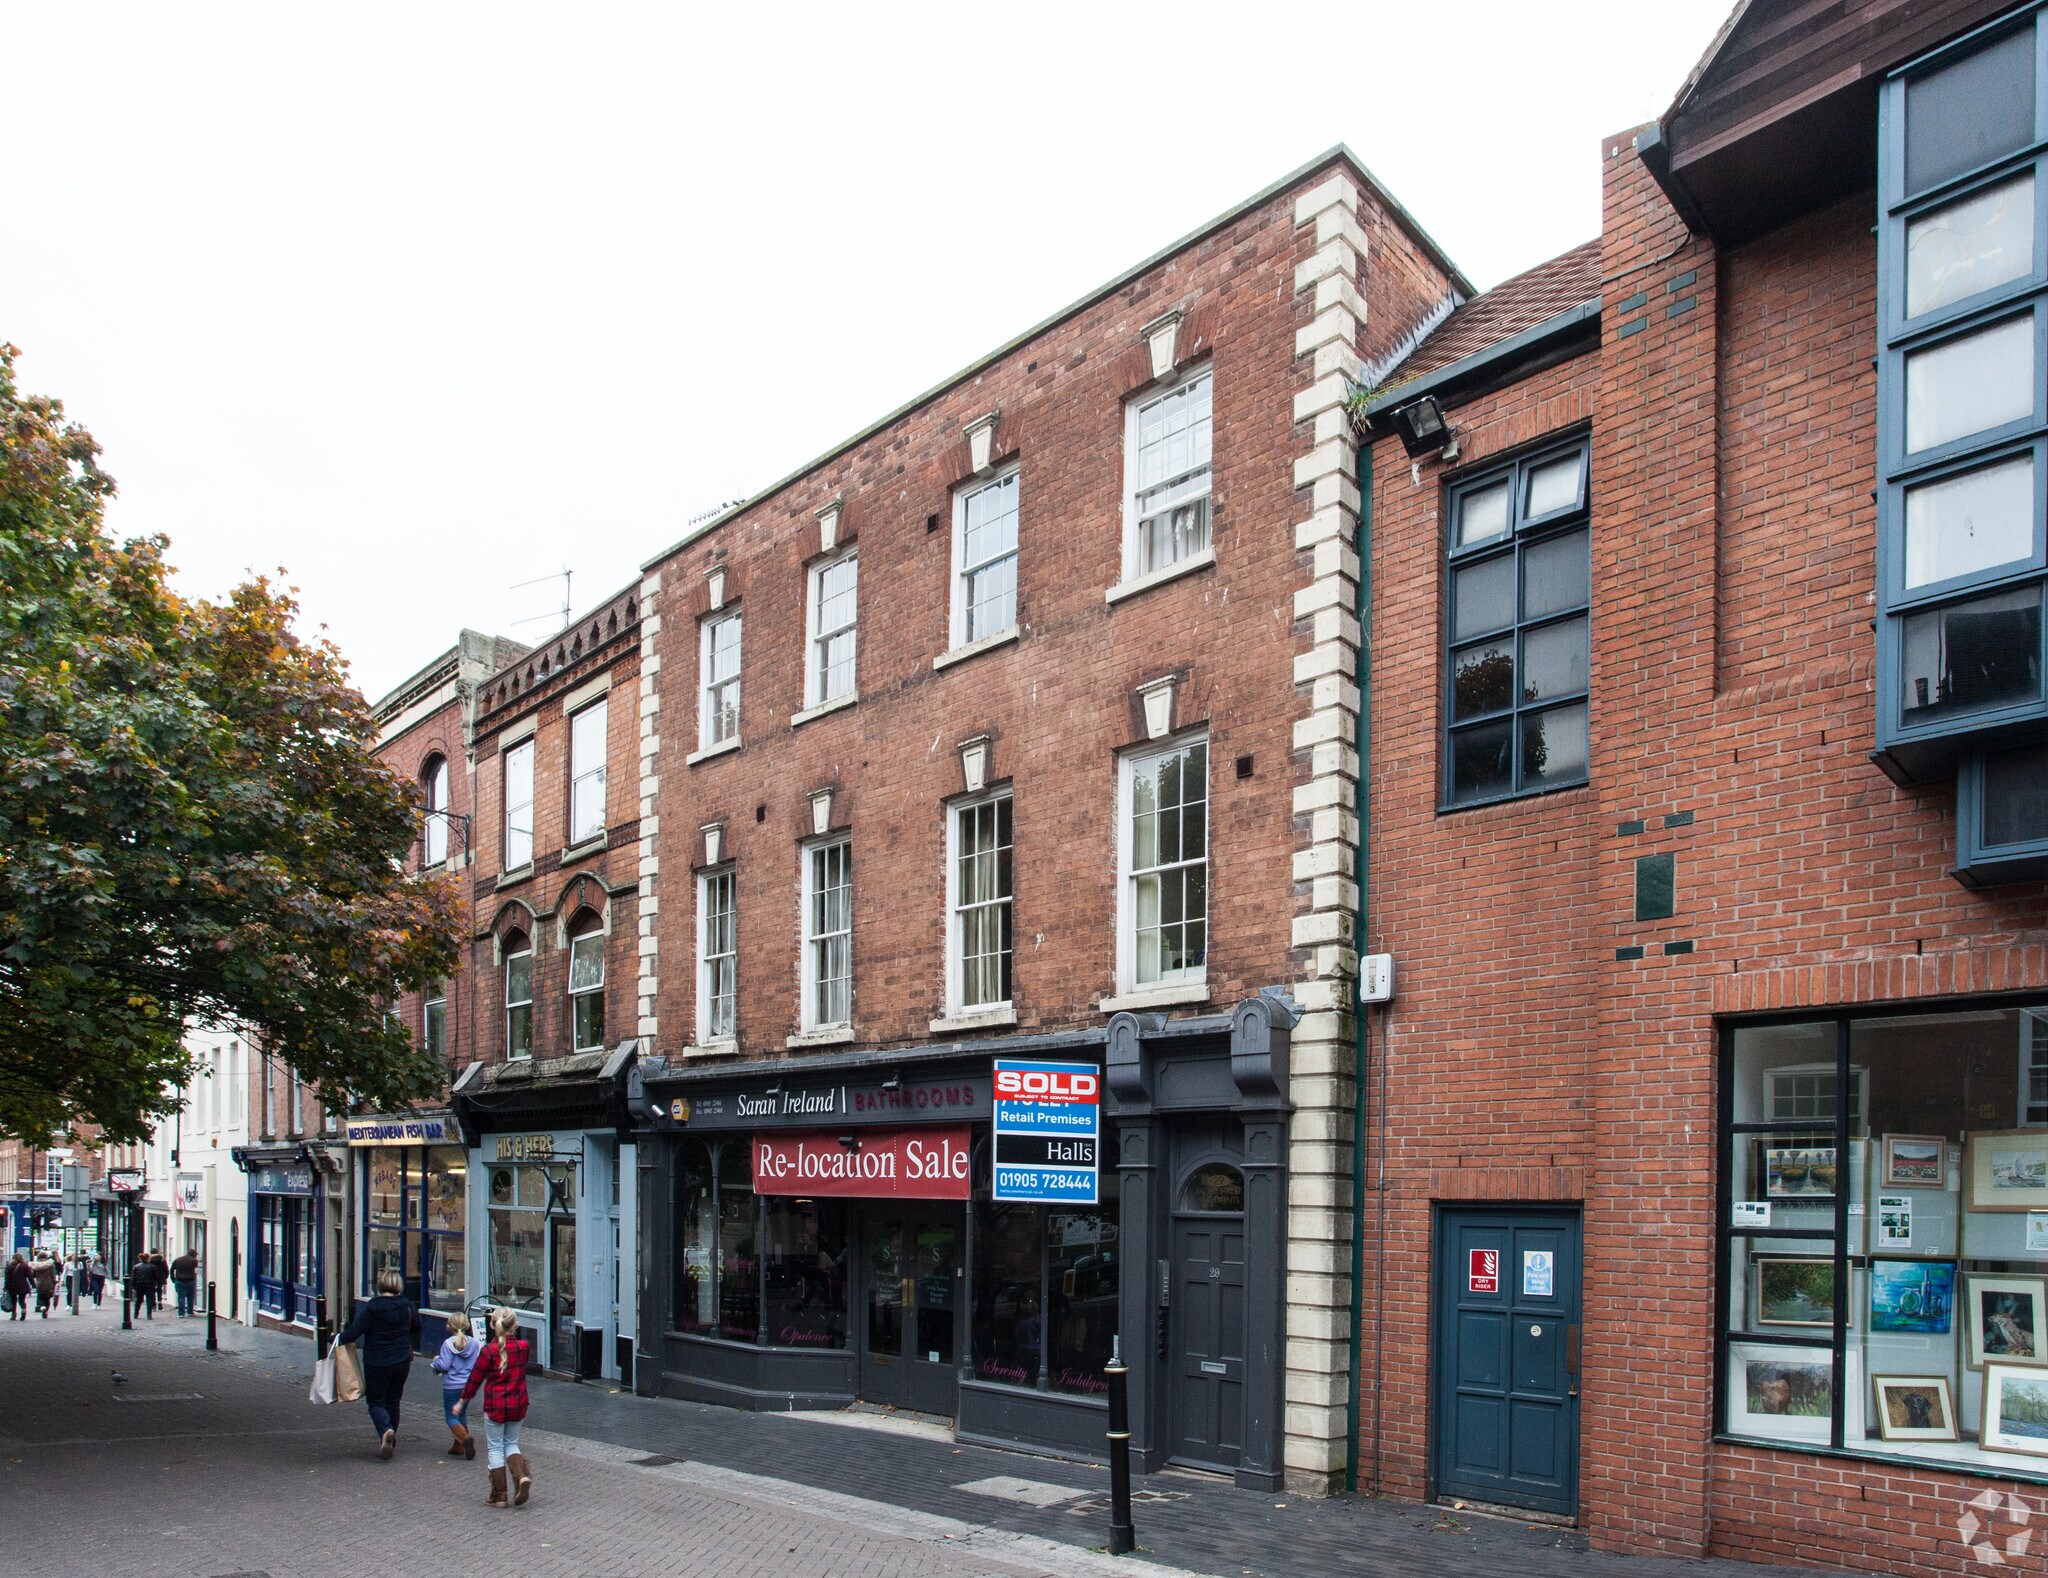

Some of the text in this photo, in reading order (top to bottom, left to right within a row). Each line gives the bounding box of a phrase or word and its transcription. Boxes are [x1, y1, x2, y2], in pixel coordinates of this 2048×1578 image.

[997, 1071, 1097, 1096] SOLD
[782, 1088, 835, 1114] Ireland
[854, 1084, 974, 1111] BATHROOMS
[1000, 1111, 1092, 1125] Retail Premises
[348, 1123, 444, 1141] MEDITERRANEAN FISH BAR
[495, 1135, 554, 1160] HIS & HERS
[758, 1138, 968, 1179] Re-location Sale
[1047, 1142, 1093, 1161] Halls
[374, 1169, 396, 1189] KEBABS
[1000, 1172, 1091, 1189] 01905 728444
[1209, 1267, 1221, 1278] 29
[781, 1326, 833, 1345] Opulence
[982, 1357, 1028, 1384] Serenity
[1057, 1368, 1109, 1393] Indulgen
